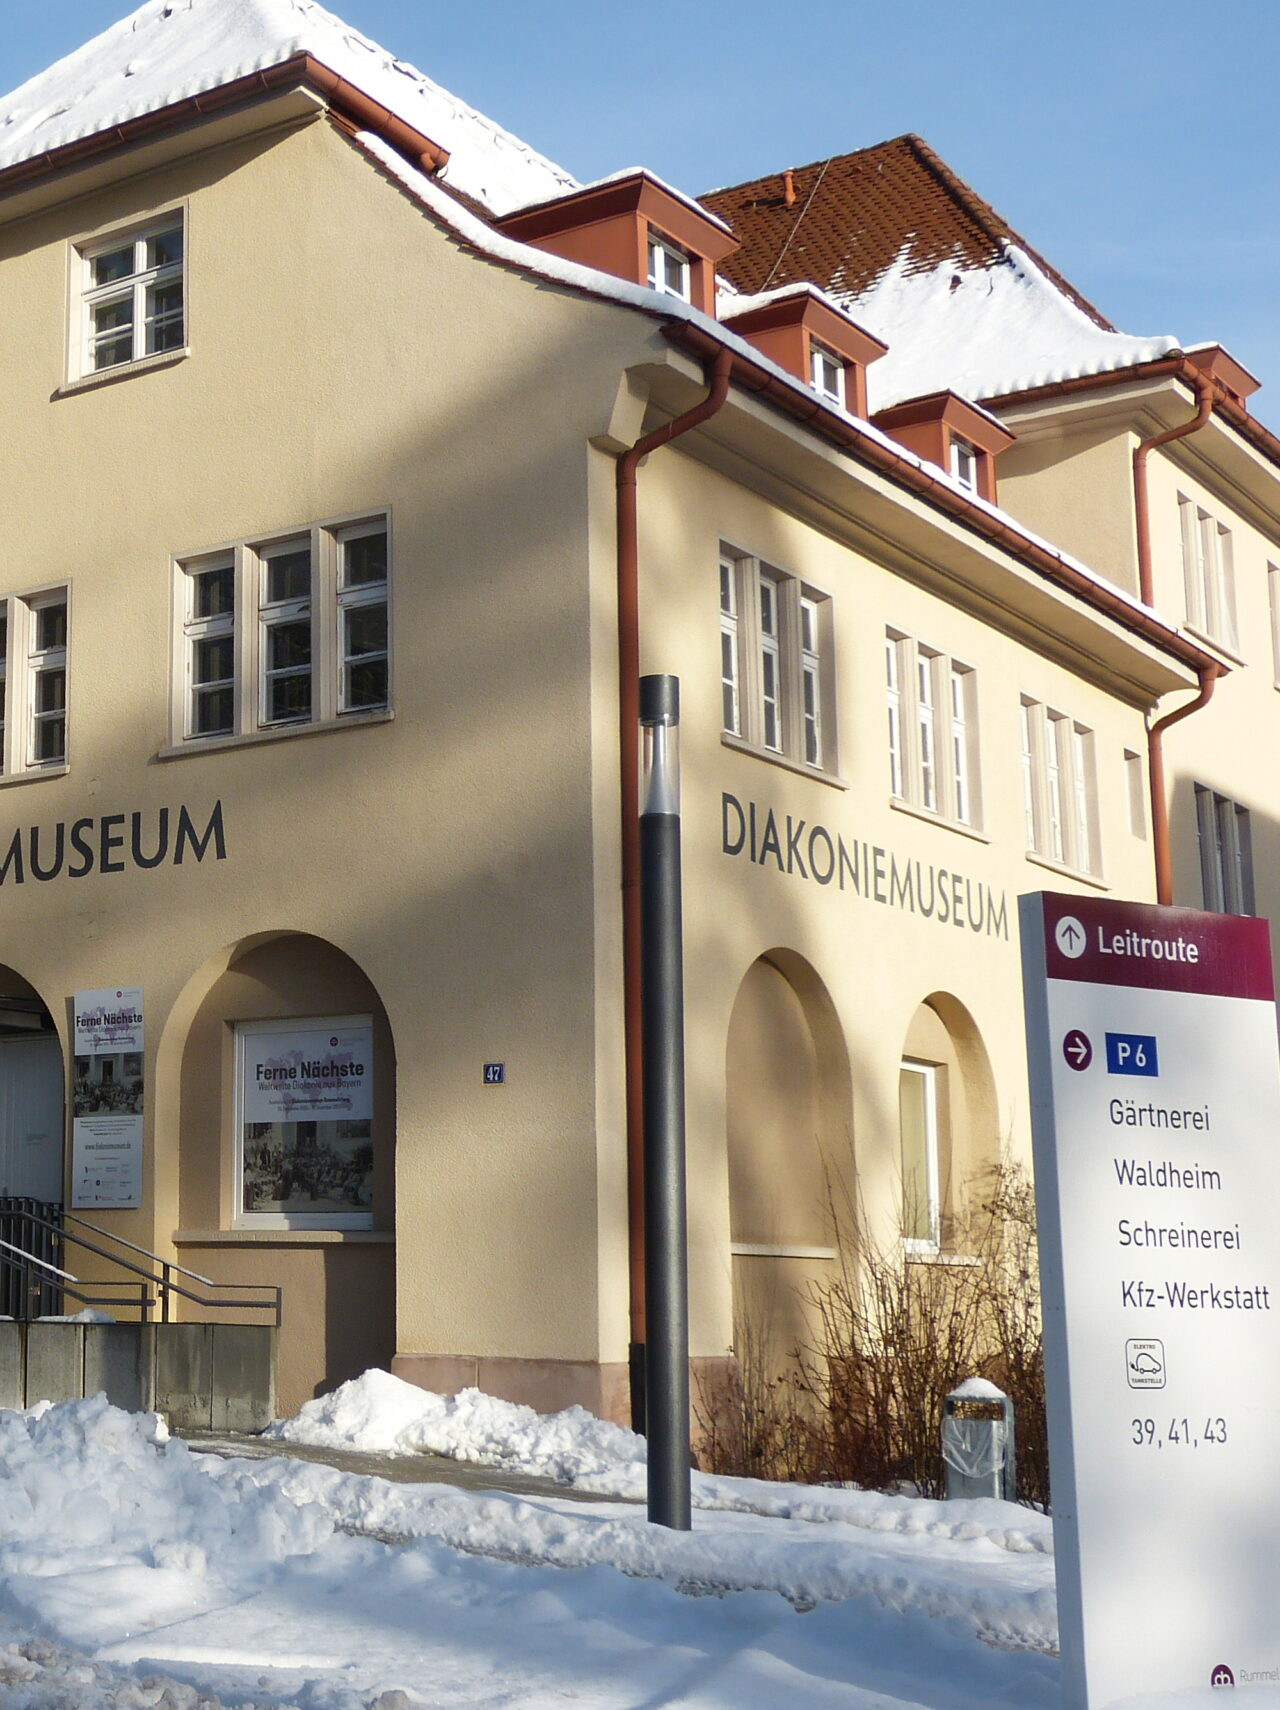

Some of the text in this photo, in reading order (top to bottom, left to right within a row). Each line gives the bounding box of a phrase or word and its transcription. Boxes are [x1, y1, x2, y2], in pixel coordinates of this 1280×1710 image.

[721, 791, 1010, 942] DIAKONIEMUSEUM
[1097, 925, 1200, 964] Leitroute
[76, 1012, 143, 1028] Ferne Nächste
[256, 1060, 365, 1081] Ferne Nächste
[1117, 1042, 1147, 1068] P 6
[486, 1066, 500, 1081] 47
[1109, 1098, 1211, 1132] Gärtnerei
[1113, 1158, 1222, 1191] Waldheim
[1118, 1218, 1241, 1251] Schreinerei
[1121, 1280, 1271, 1310] Kfz-Werkstatt
[1131, 1417, 1228, 1449] 39, 41, 43
